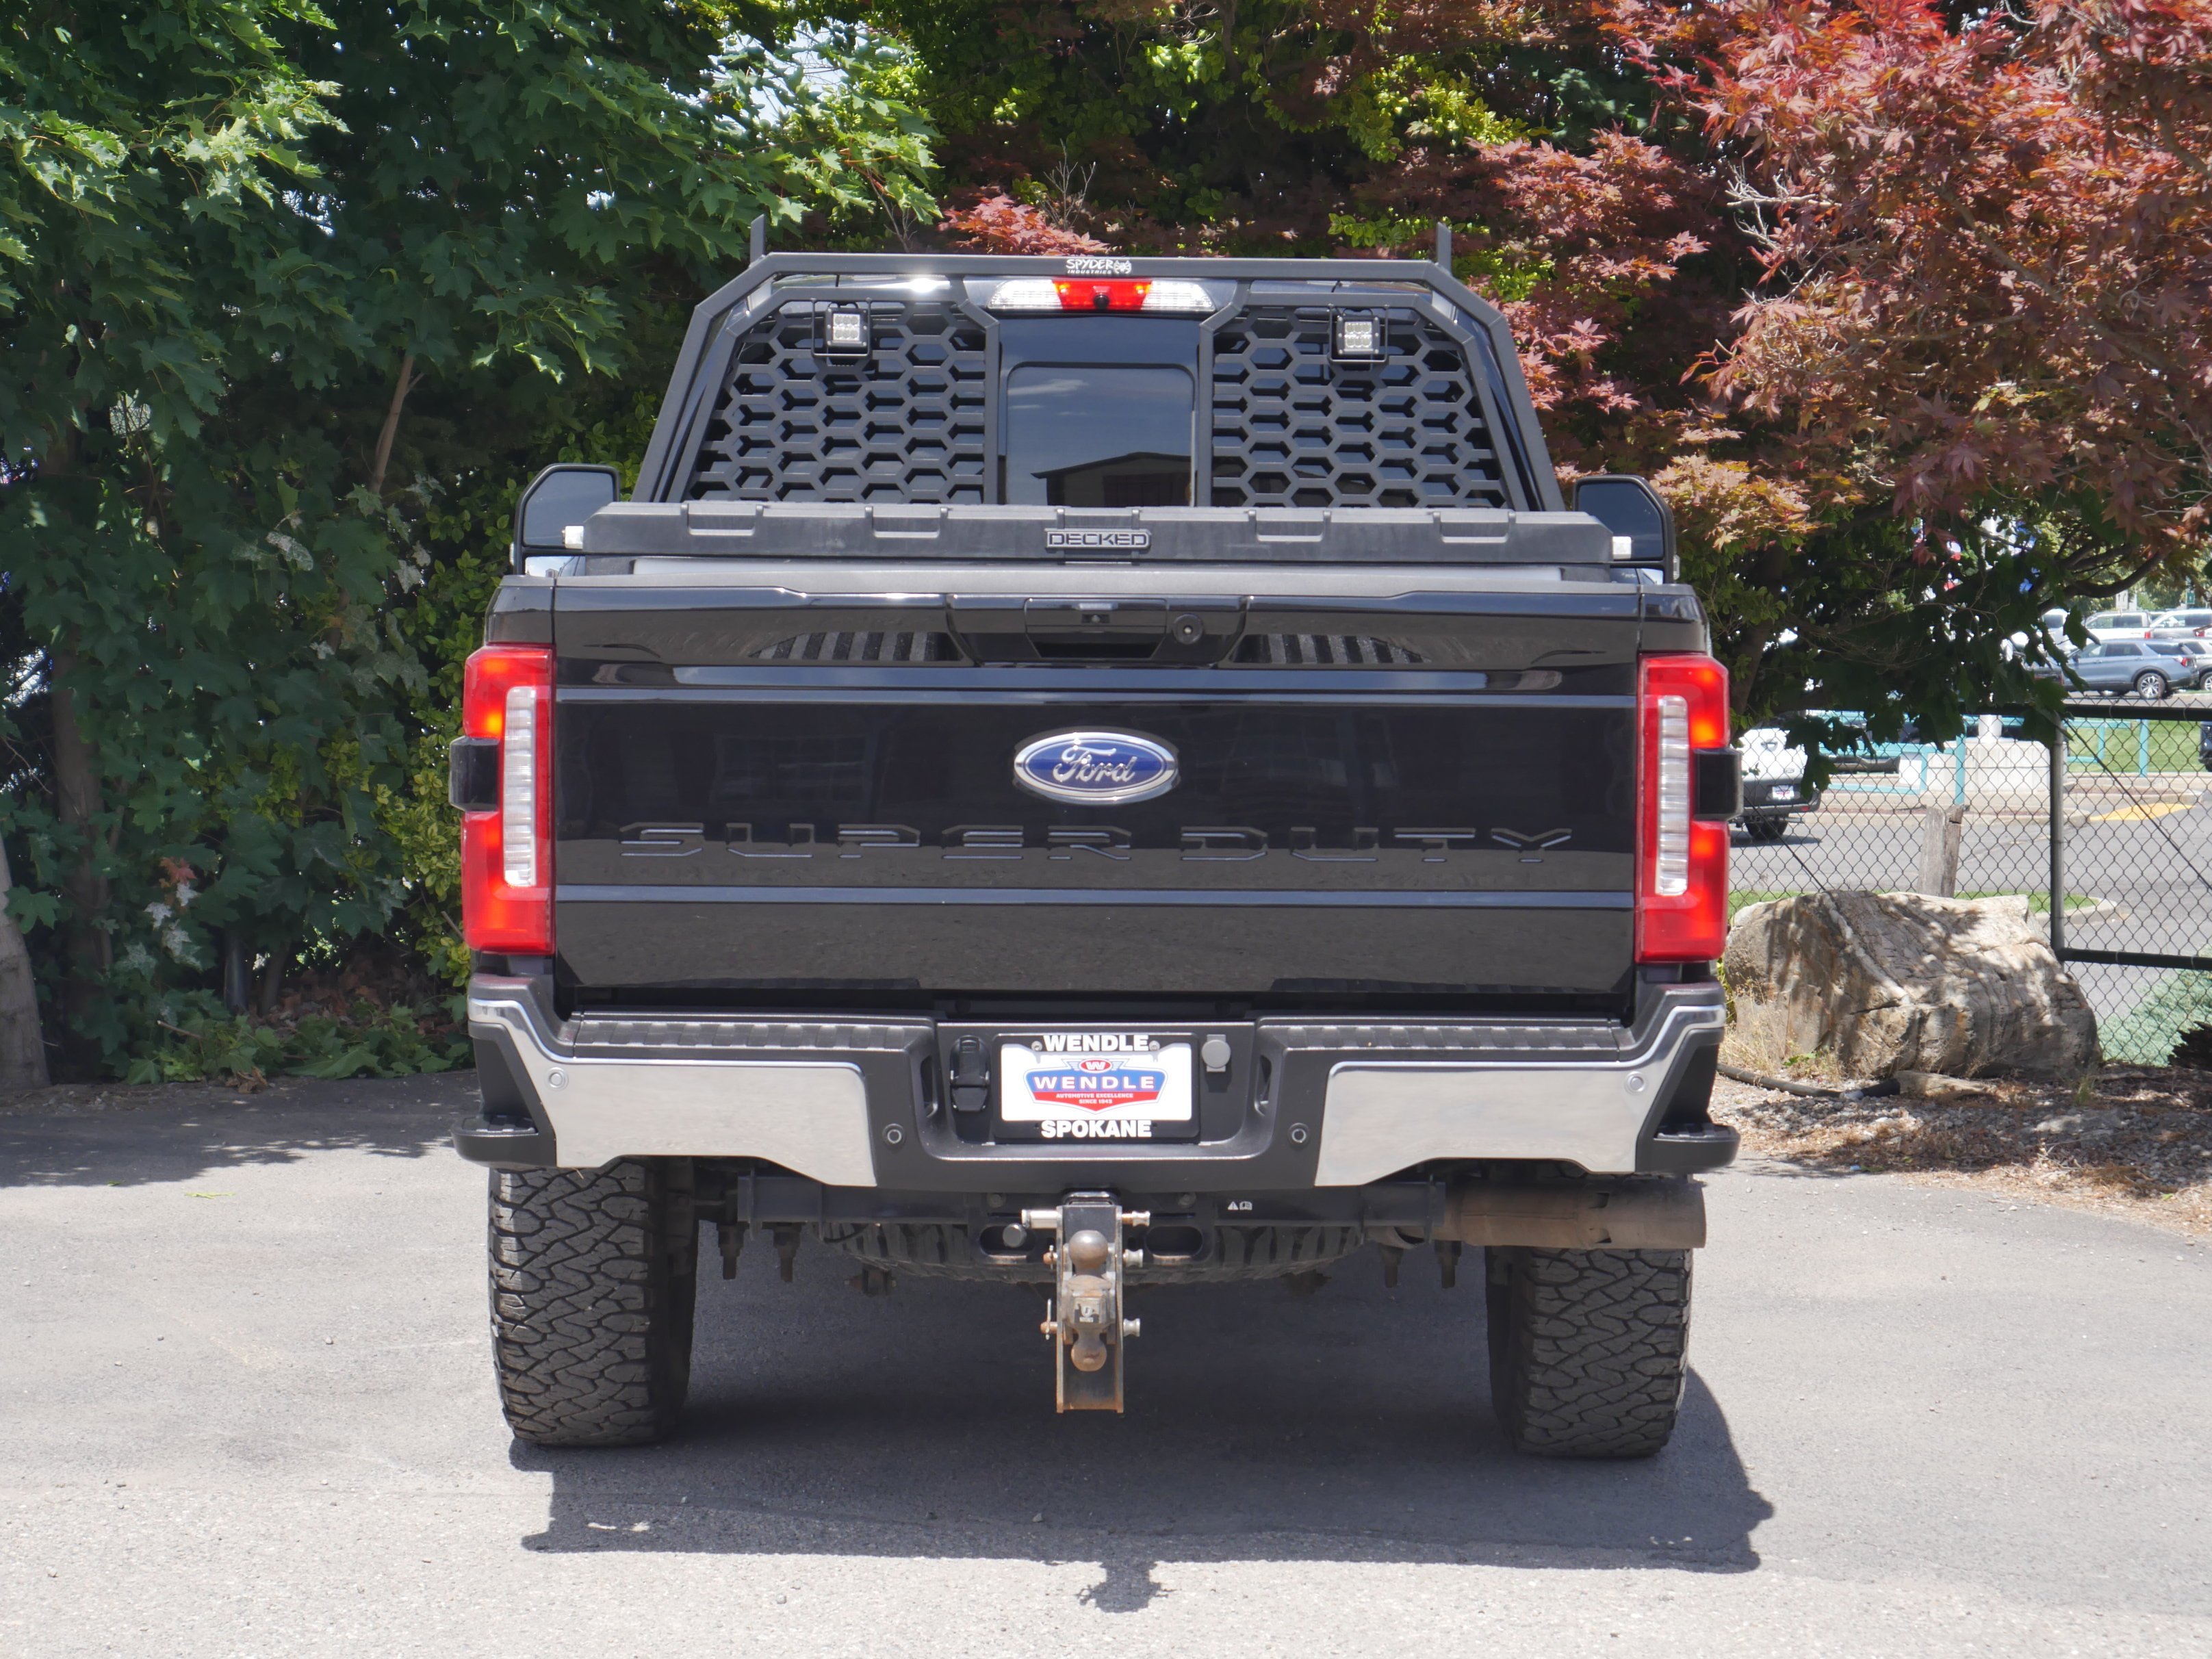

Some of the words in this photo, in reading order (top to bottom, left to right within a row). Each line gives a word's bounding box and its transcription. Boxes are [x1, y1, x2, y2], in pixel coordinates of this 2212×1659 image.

[1066, 259, 1114, 270] SPYDER
[1049, 533, 1147, 545] DECKED
[1053, 745, 1137, 782] Ford
[621, 823, 1131, 860] SUPER
[1181, 826, 1572, 863] DUTY
[1043, 1034, 1149, 1051] WENDLE
[1085, 1062, 1105, 1070] W
[1034, 1076, 1155, 1089] WENDLE
[1041, 1120, 1152, 1137] SPOKANE
